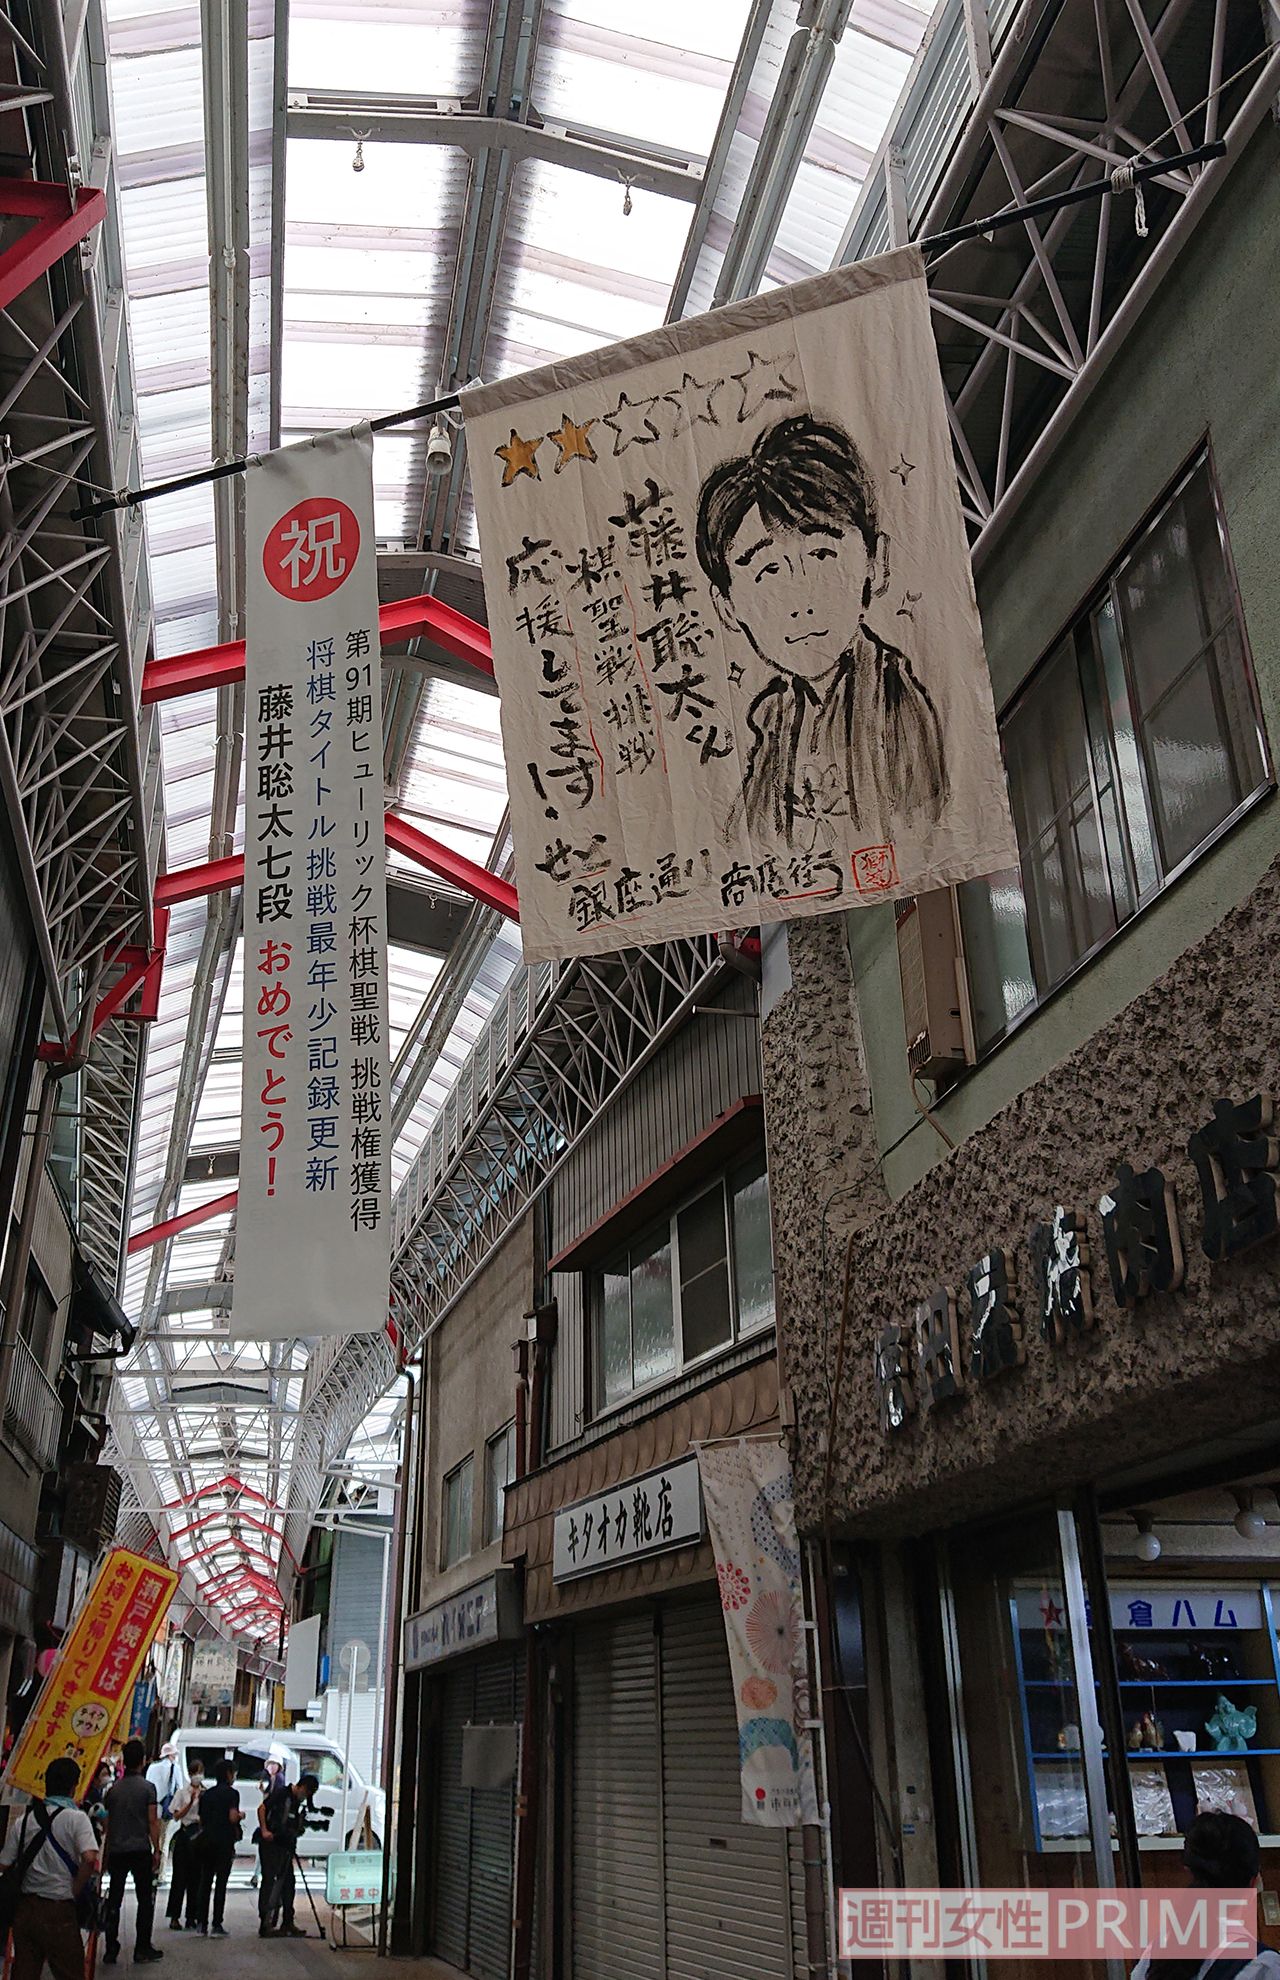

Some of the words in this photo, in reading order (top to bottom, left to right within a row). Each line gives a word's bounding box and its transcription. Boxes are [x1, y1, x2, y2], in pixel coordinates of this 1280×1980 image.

[279, 515, 346, 588] 祝
[565, 535, 655, 776] 棋聖戦挑戦
[608, 477, 734, 766] 藤井聡太くん
[256, 684, 294, 924] 藤井聡太七段
[305, 637, 340, 1193] 将棋タイトル挑戦最年少記録更新
[345, 628, 381, 1047] 第91期ヒューリック杯棋聖戦
[256, 939, 292, 1197] おめでとう!
[348, 1056, 382, 1233] 挑戦権獲得
[97, 1576, 164, 1693] 瀬戸焼そば
[568, 1477, 673, 1564] キタオカ靴店
[1085, 1600, 1238, 1628] 倉ハム
